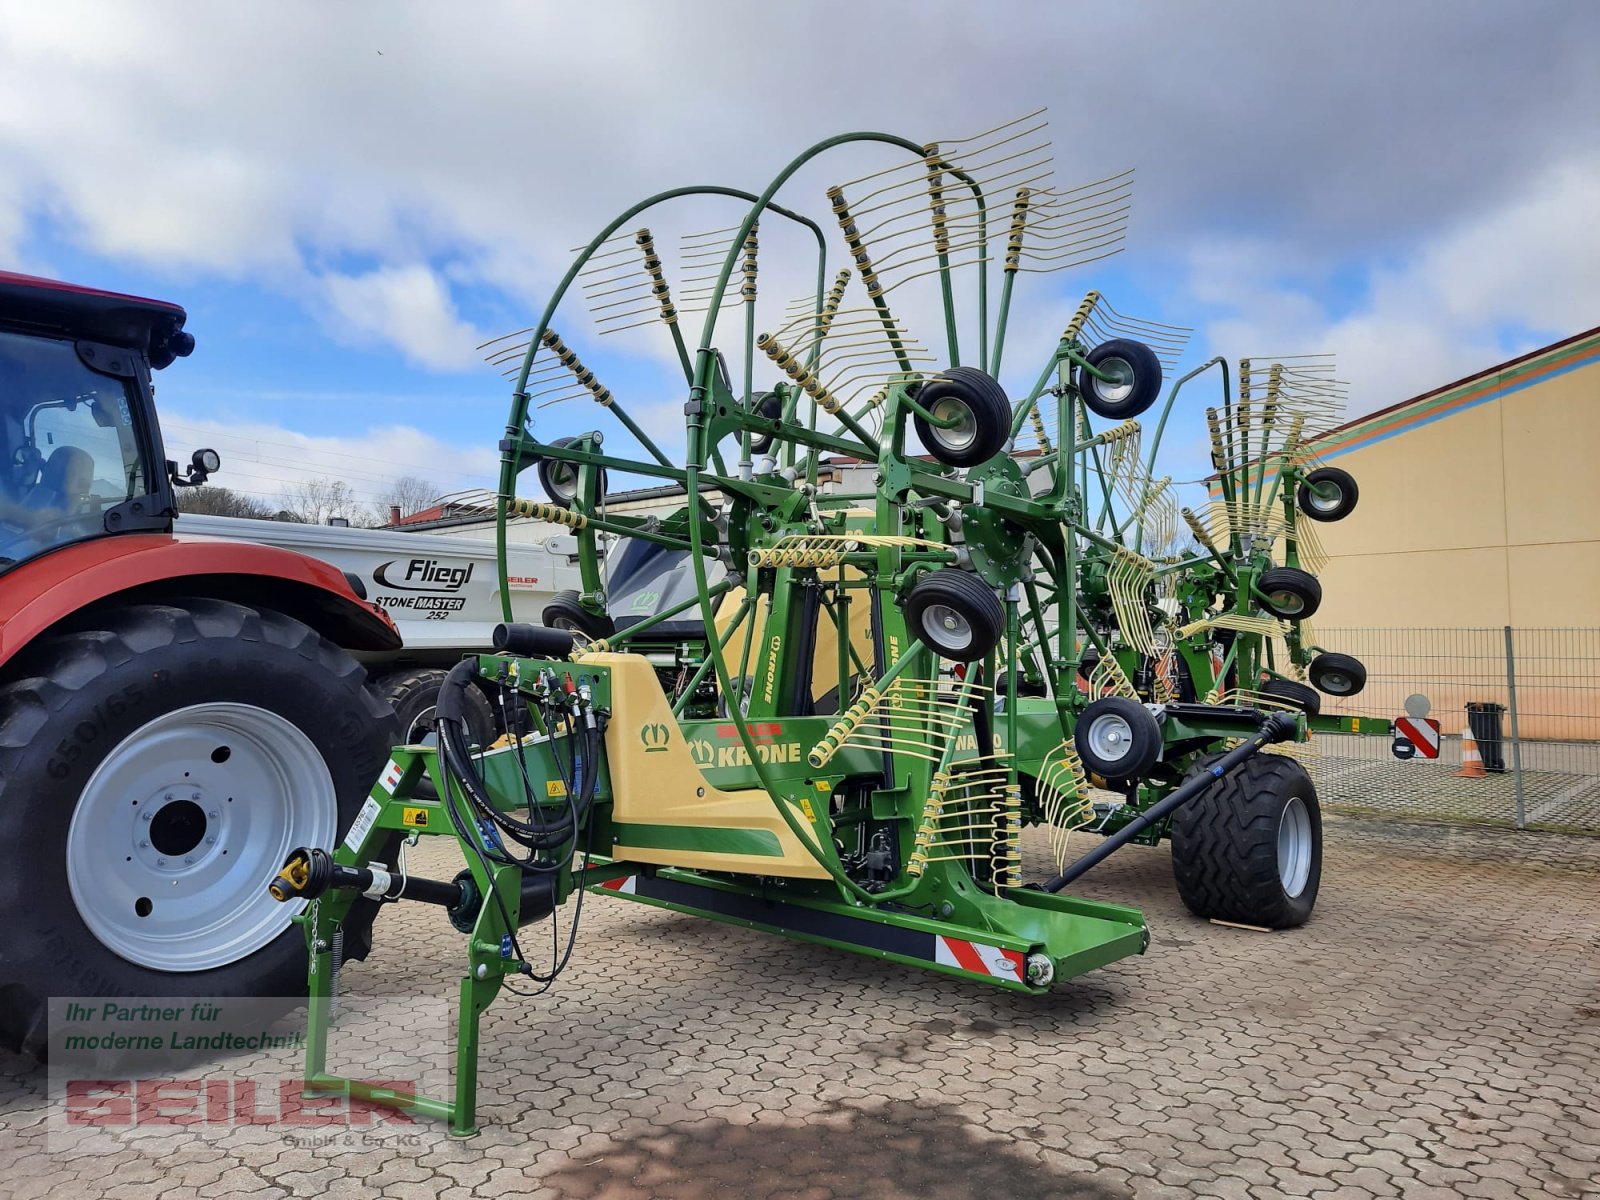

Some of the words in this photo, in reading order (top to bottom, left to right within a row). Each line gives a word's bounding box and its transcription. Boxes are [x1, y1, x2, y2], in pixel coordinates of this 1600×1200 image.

[405, 559, 475, 589] Fliegl
[376, 596, 416, 608] STONE
[416, 597, 465, 610] MASTER
[425, 611, 449, 620] 252
[764, 651, 777, 704] KRONE
